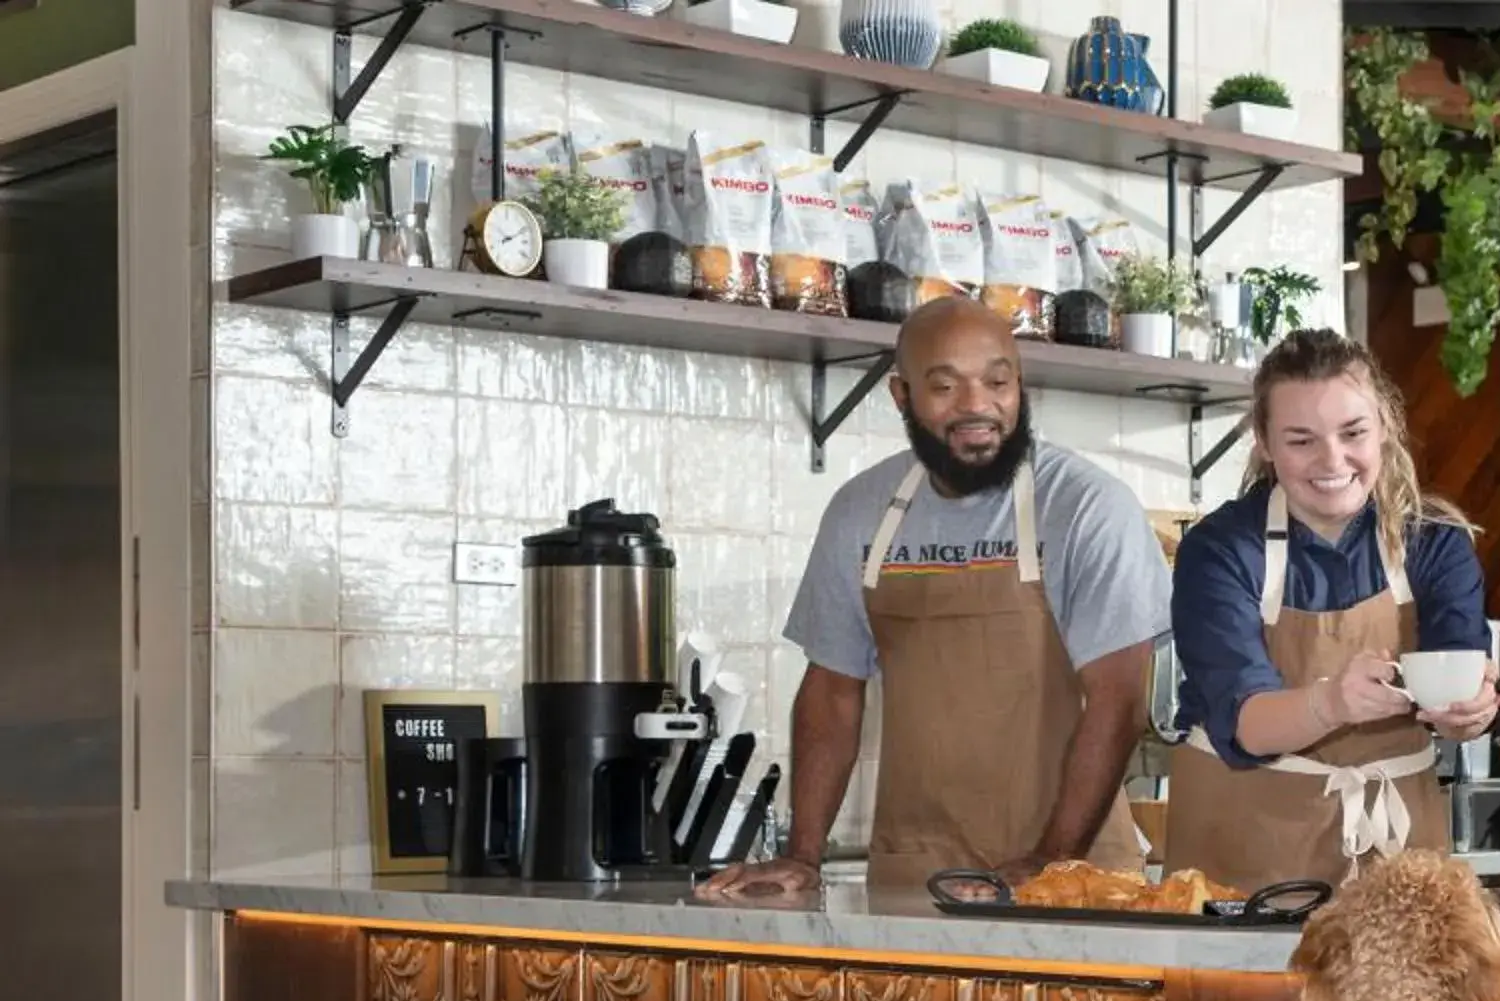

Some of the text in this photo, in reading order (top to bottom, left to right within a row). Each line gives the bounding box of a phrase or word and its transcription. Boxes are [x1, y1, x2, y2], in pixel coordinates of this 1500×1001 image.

[711, 177, 769, 193] KIMBO
[785, 193, 837, 209] KIMBO
[895, 545, 911, 561] A
[918, 543, 967, 563] NICE
[395, 719, 445, 737] COFFEE
[417, 787, 426, 805] 7
